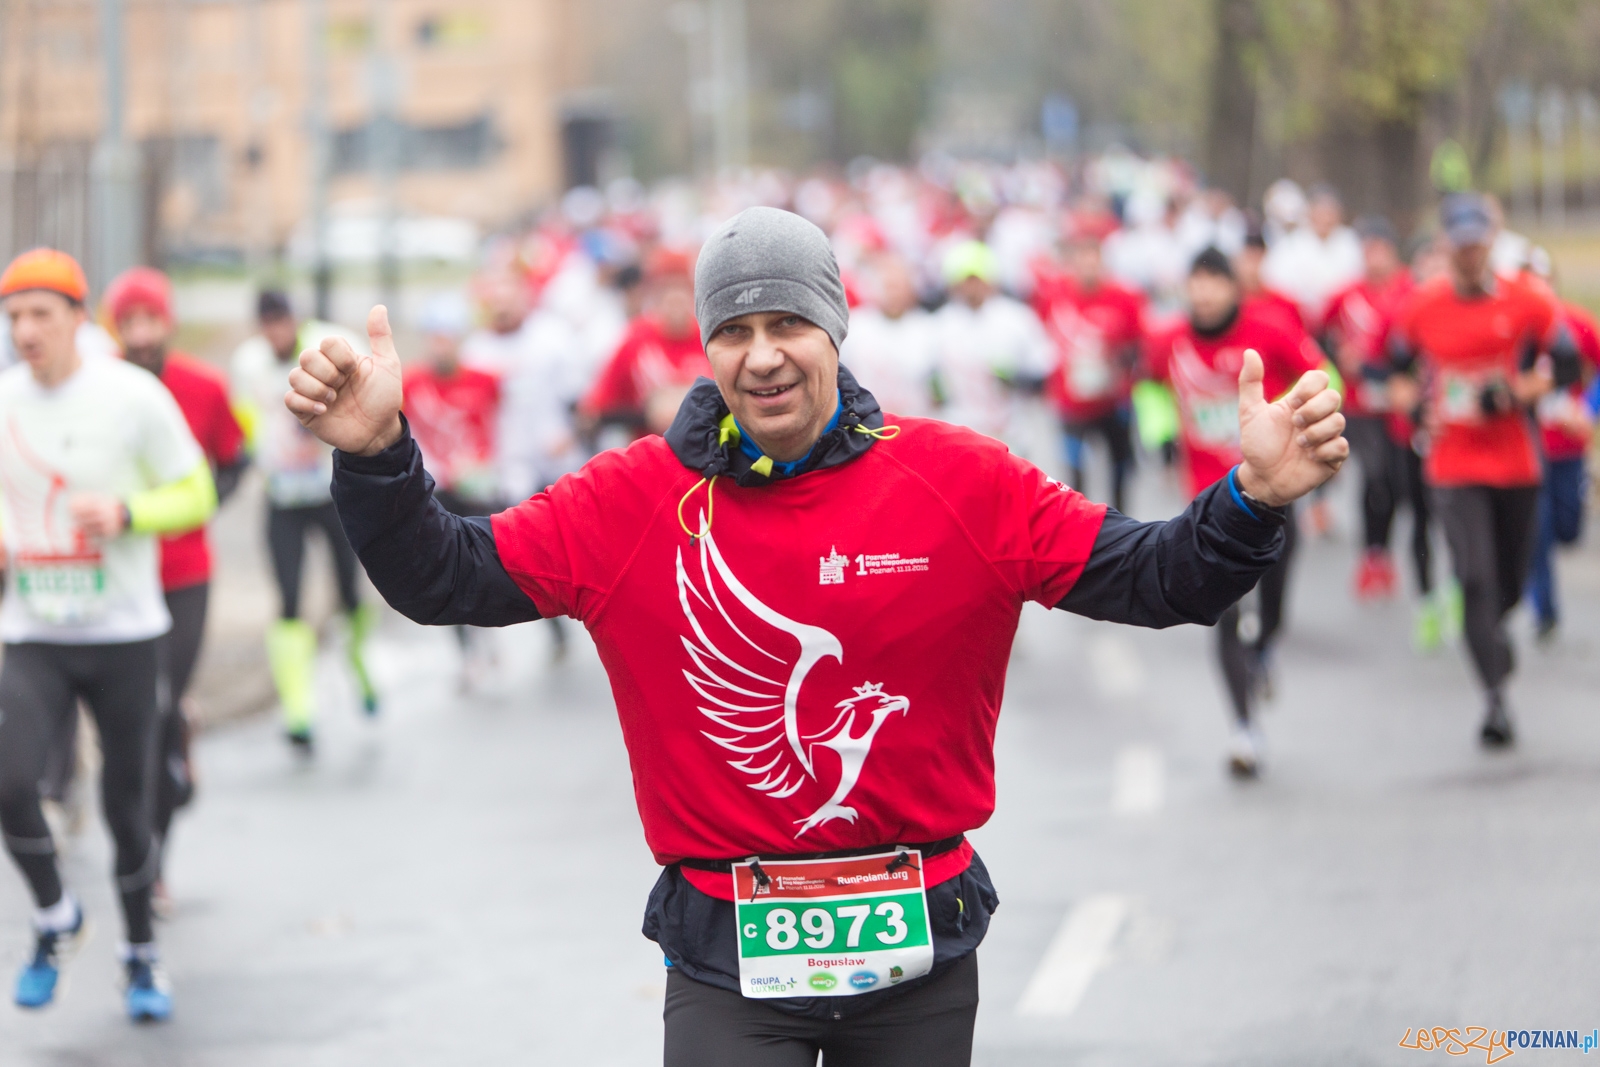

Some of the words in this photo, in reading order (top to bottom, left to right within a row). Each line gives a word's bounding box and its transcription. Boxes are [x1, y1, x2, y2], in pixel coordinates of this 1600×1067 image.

[735, 287, 762, 304] 4F
[854, 553, 868, 576] 1
[896, 564, 929, 573] 11.11.2016
[776, 875, 785, 890] 1
[837, 870, 909, 885] RunPoland.org
[765, 901, 909, 951] 8973
[807, 957, 866, 969] Bogusław
[750, 976, 781, 986] GRUPA
[751, 984, 787, 993] LUXMED
